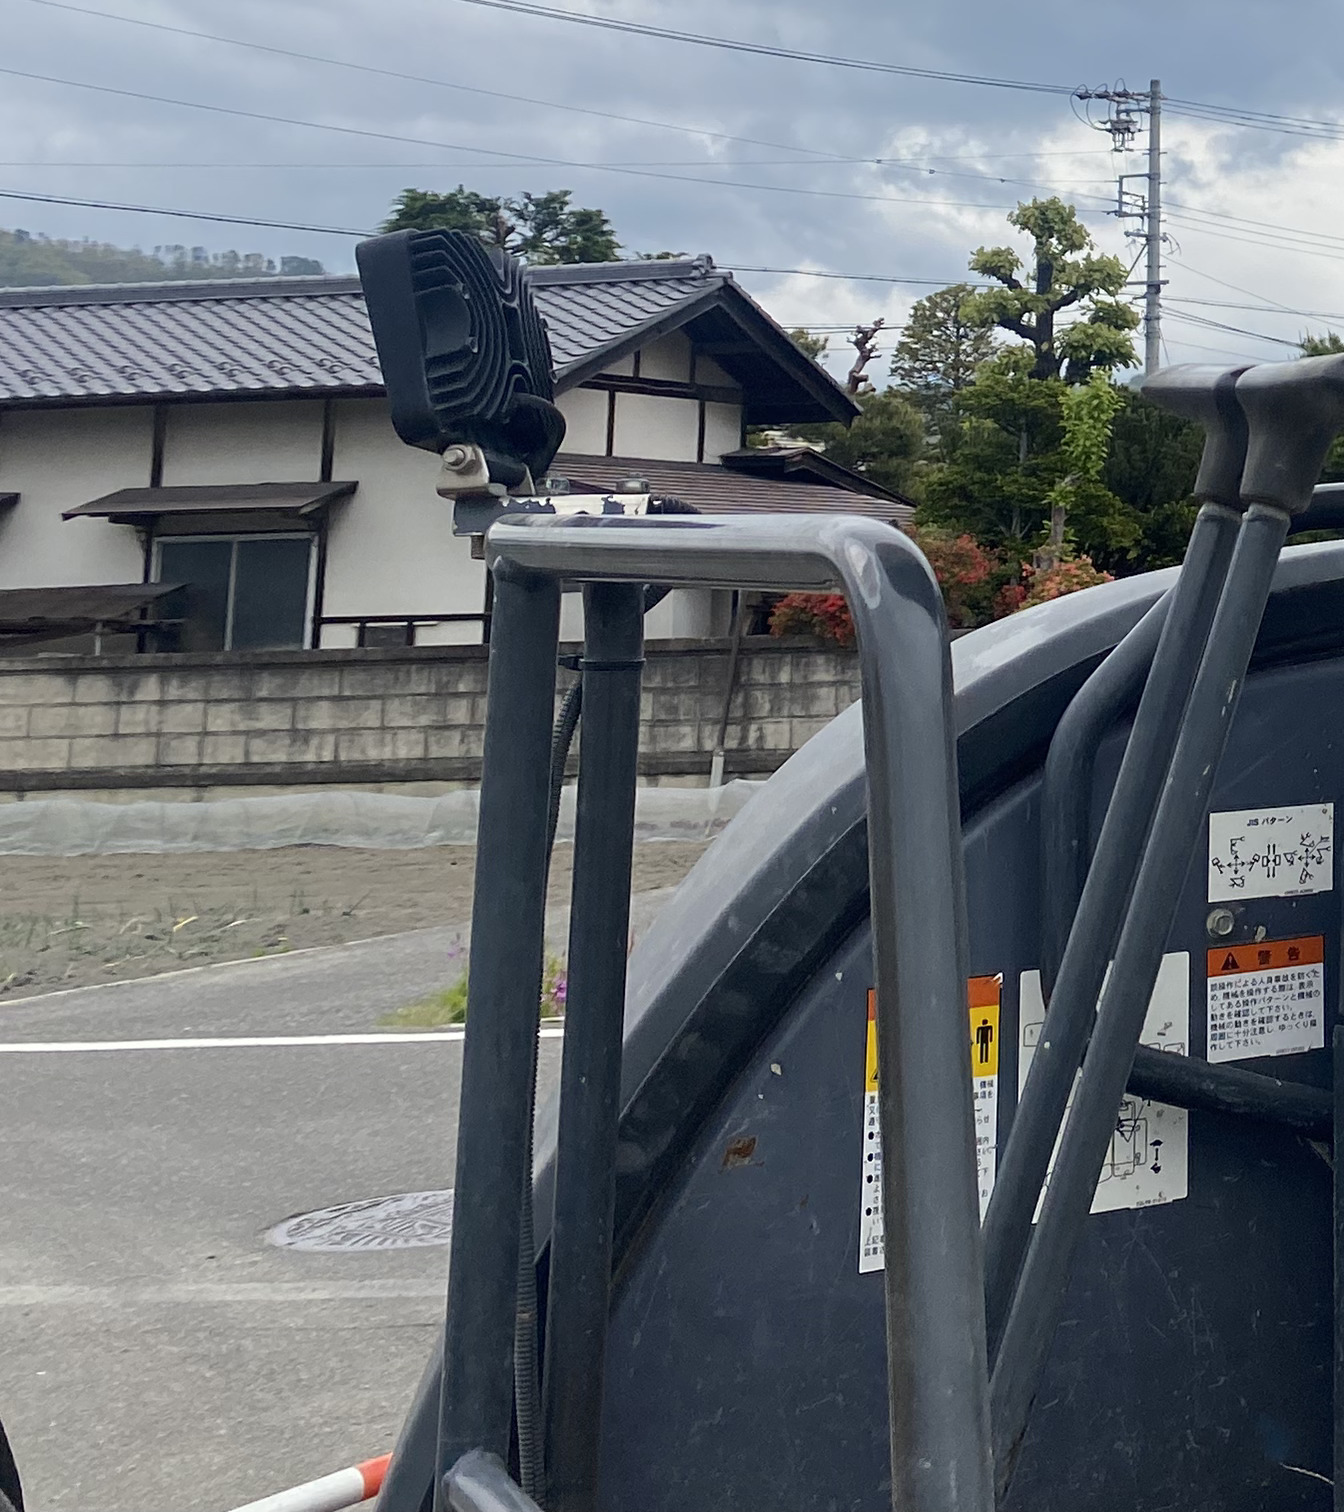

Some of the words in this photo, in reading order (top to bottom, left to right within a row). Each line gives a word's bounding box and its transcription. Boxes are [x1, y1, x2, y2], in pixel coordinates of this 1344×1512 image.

[1247, 818, 1259, 826] JIS
[1261, 816, 1294, 826] パターン
